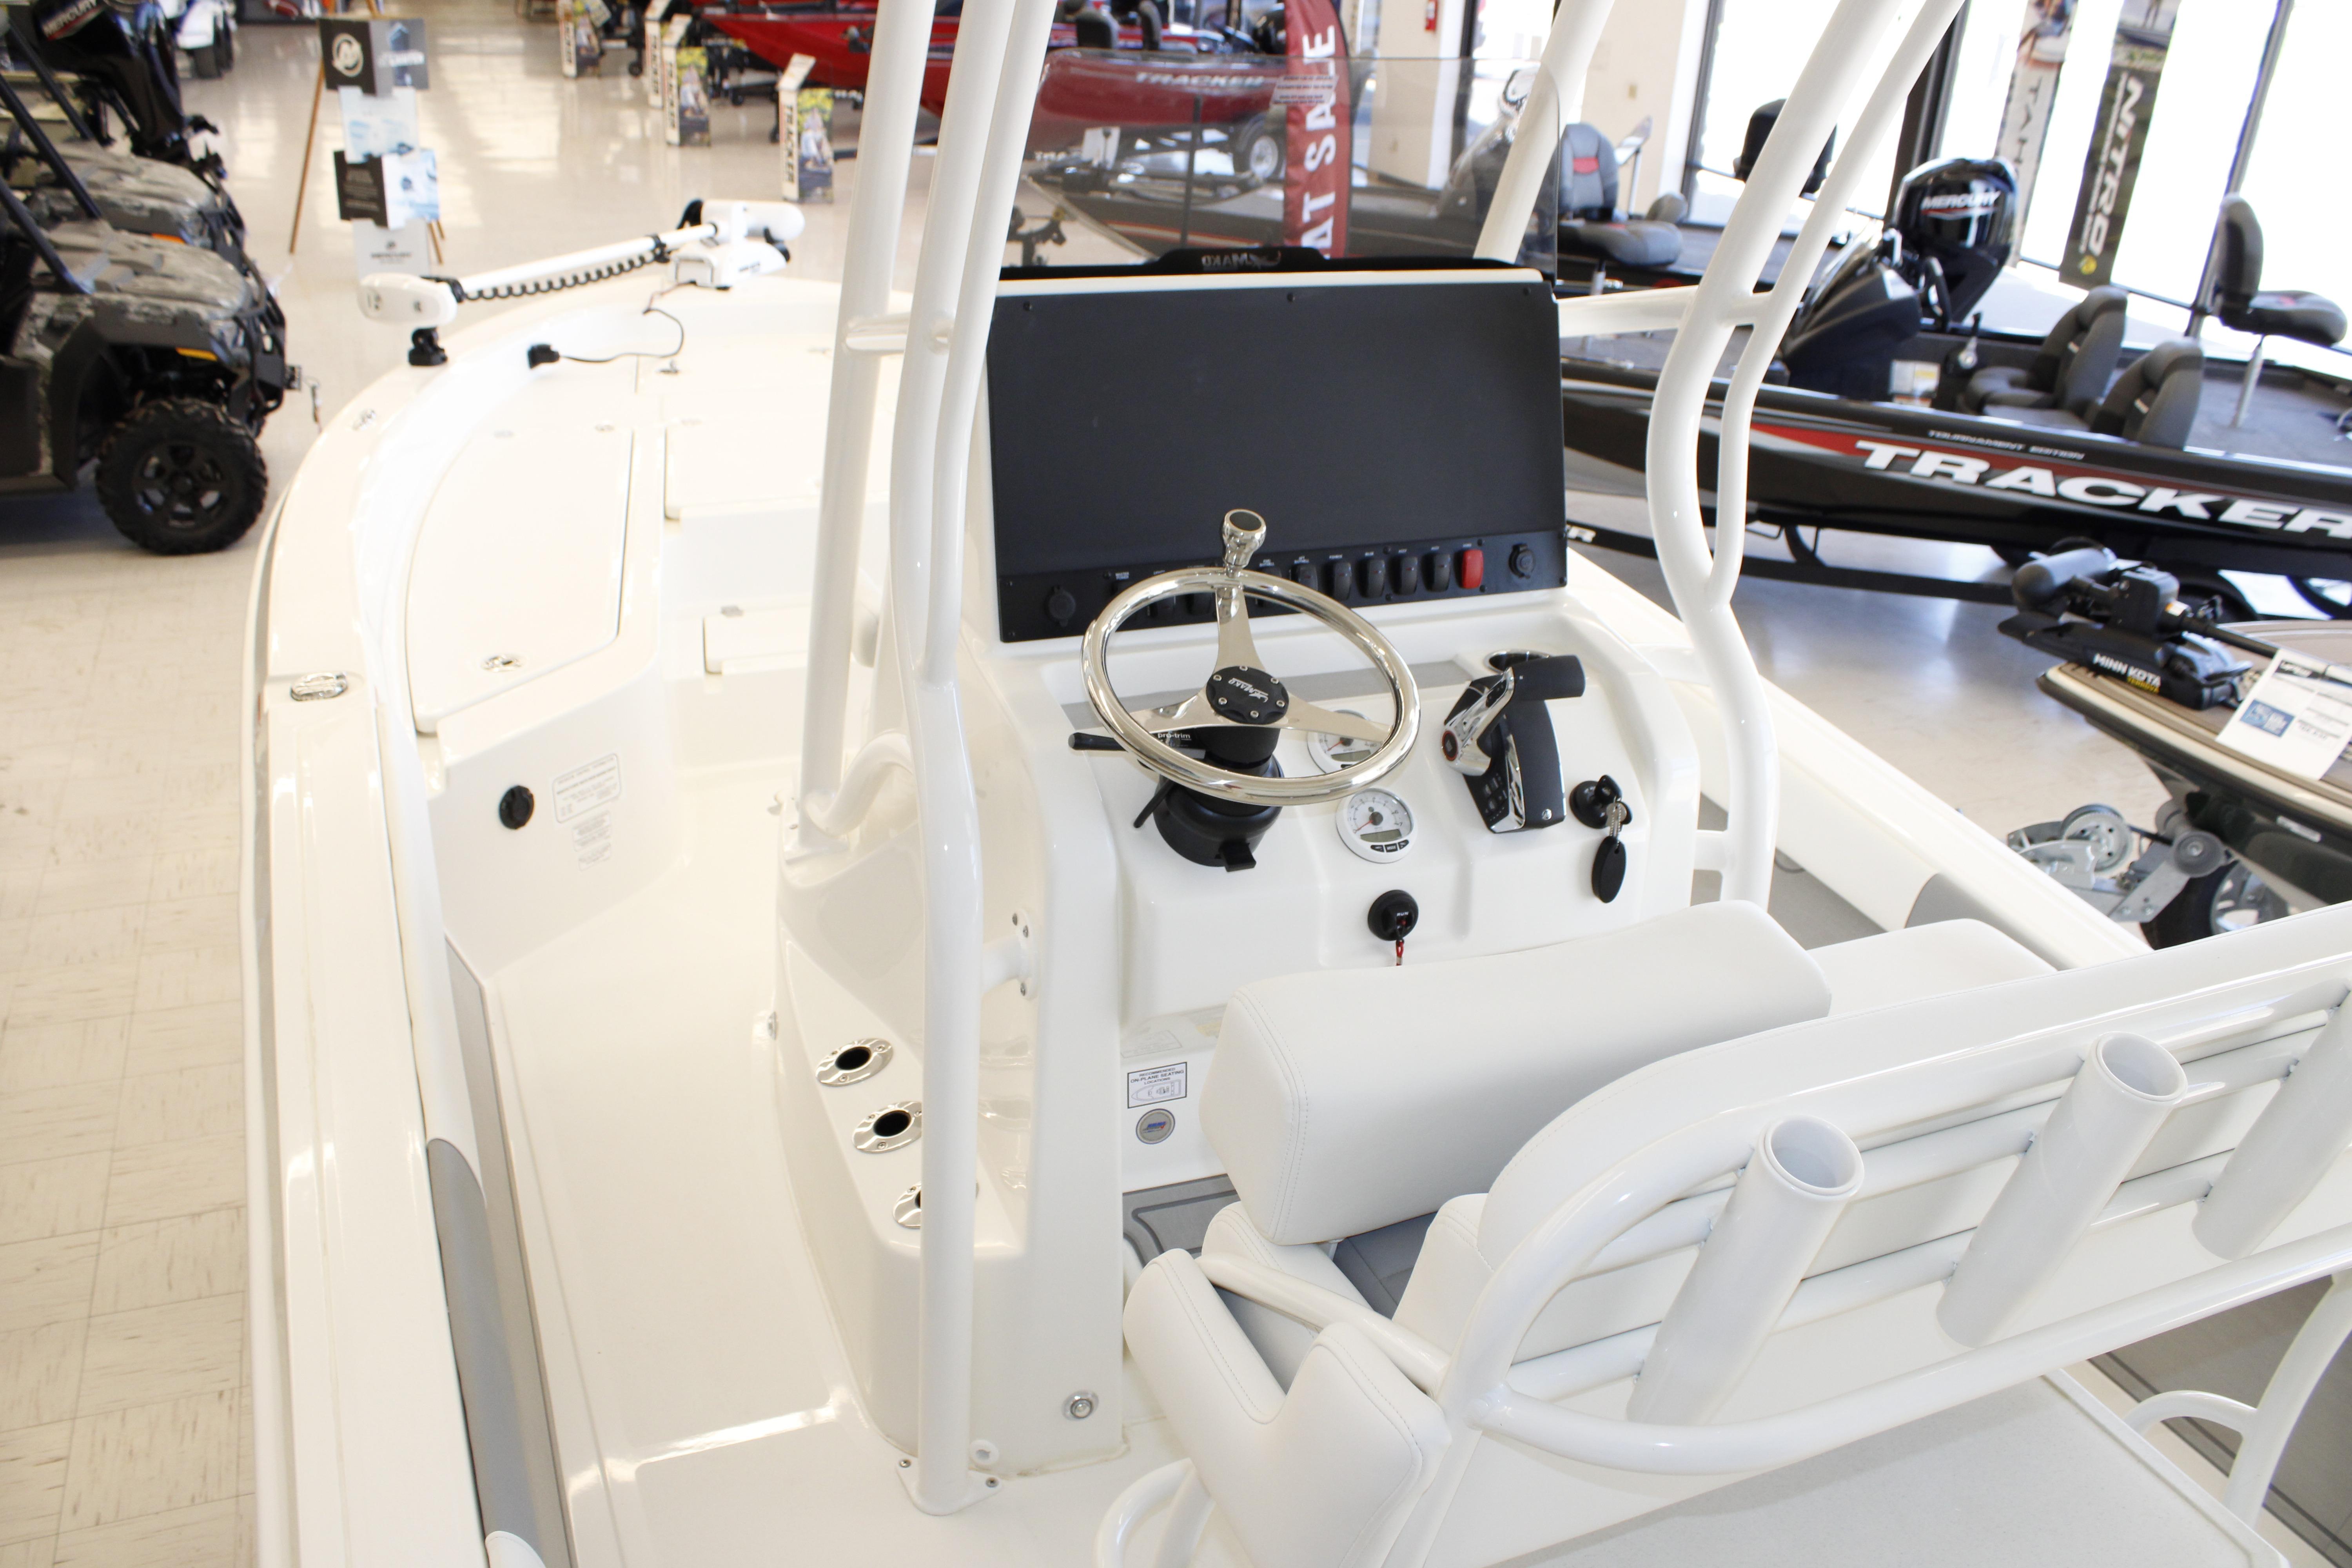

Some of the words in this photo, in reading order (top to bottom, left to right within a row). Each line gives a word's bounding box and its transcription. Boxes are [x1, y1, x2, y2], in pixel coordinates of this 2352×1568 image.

[2089, 76, 2144, 256] NITRO
[1920, 191, 2002, 211] MERCURY
[1301, 191, 1336, 260] AT
[1928, 430, 2025, 451] TOURNAMENT
[2029, 445, 2085, 461] EDITION
[1856, 440, 2352, 540] TRACKER
[2092, 653, 2129, 675] MINN
[2127, 666, 2161, 688] KOTA
[1131, 1075, 1160, 1083] ON-PLANE
[1139, 1067, 1176, 1077] RECOMMENDED
[1144, 1077, 1171, 1085] LOCATIONS
